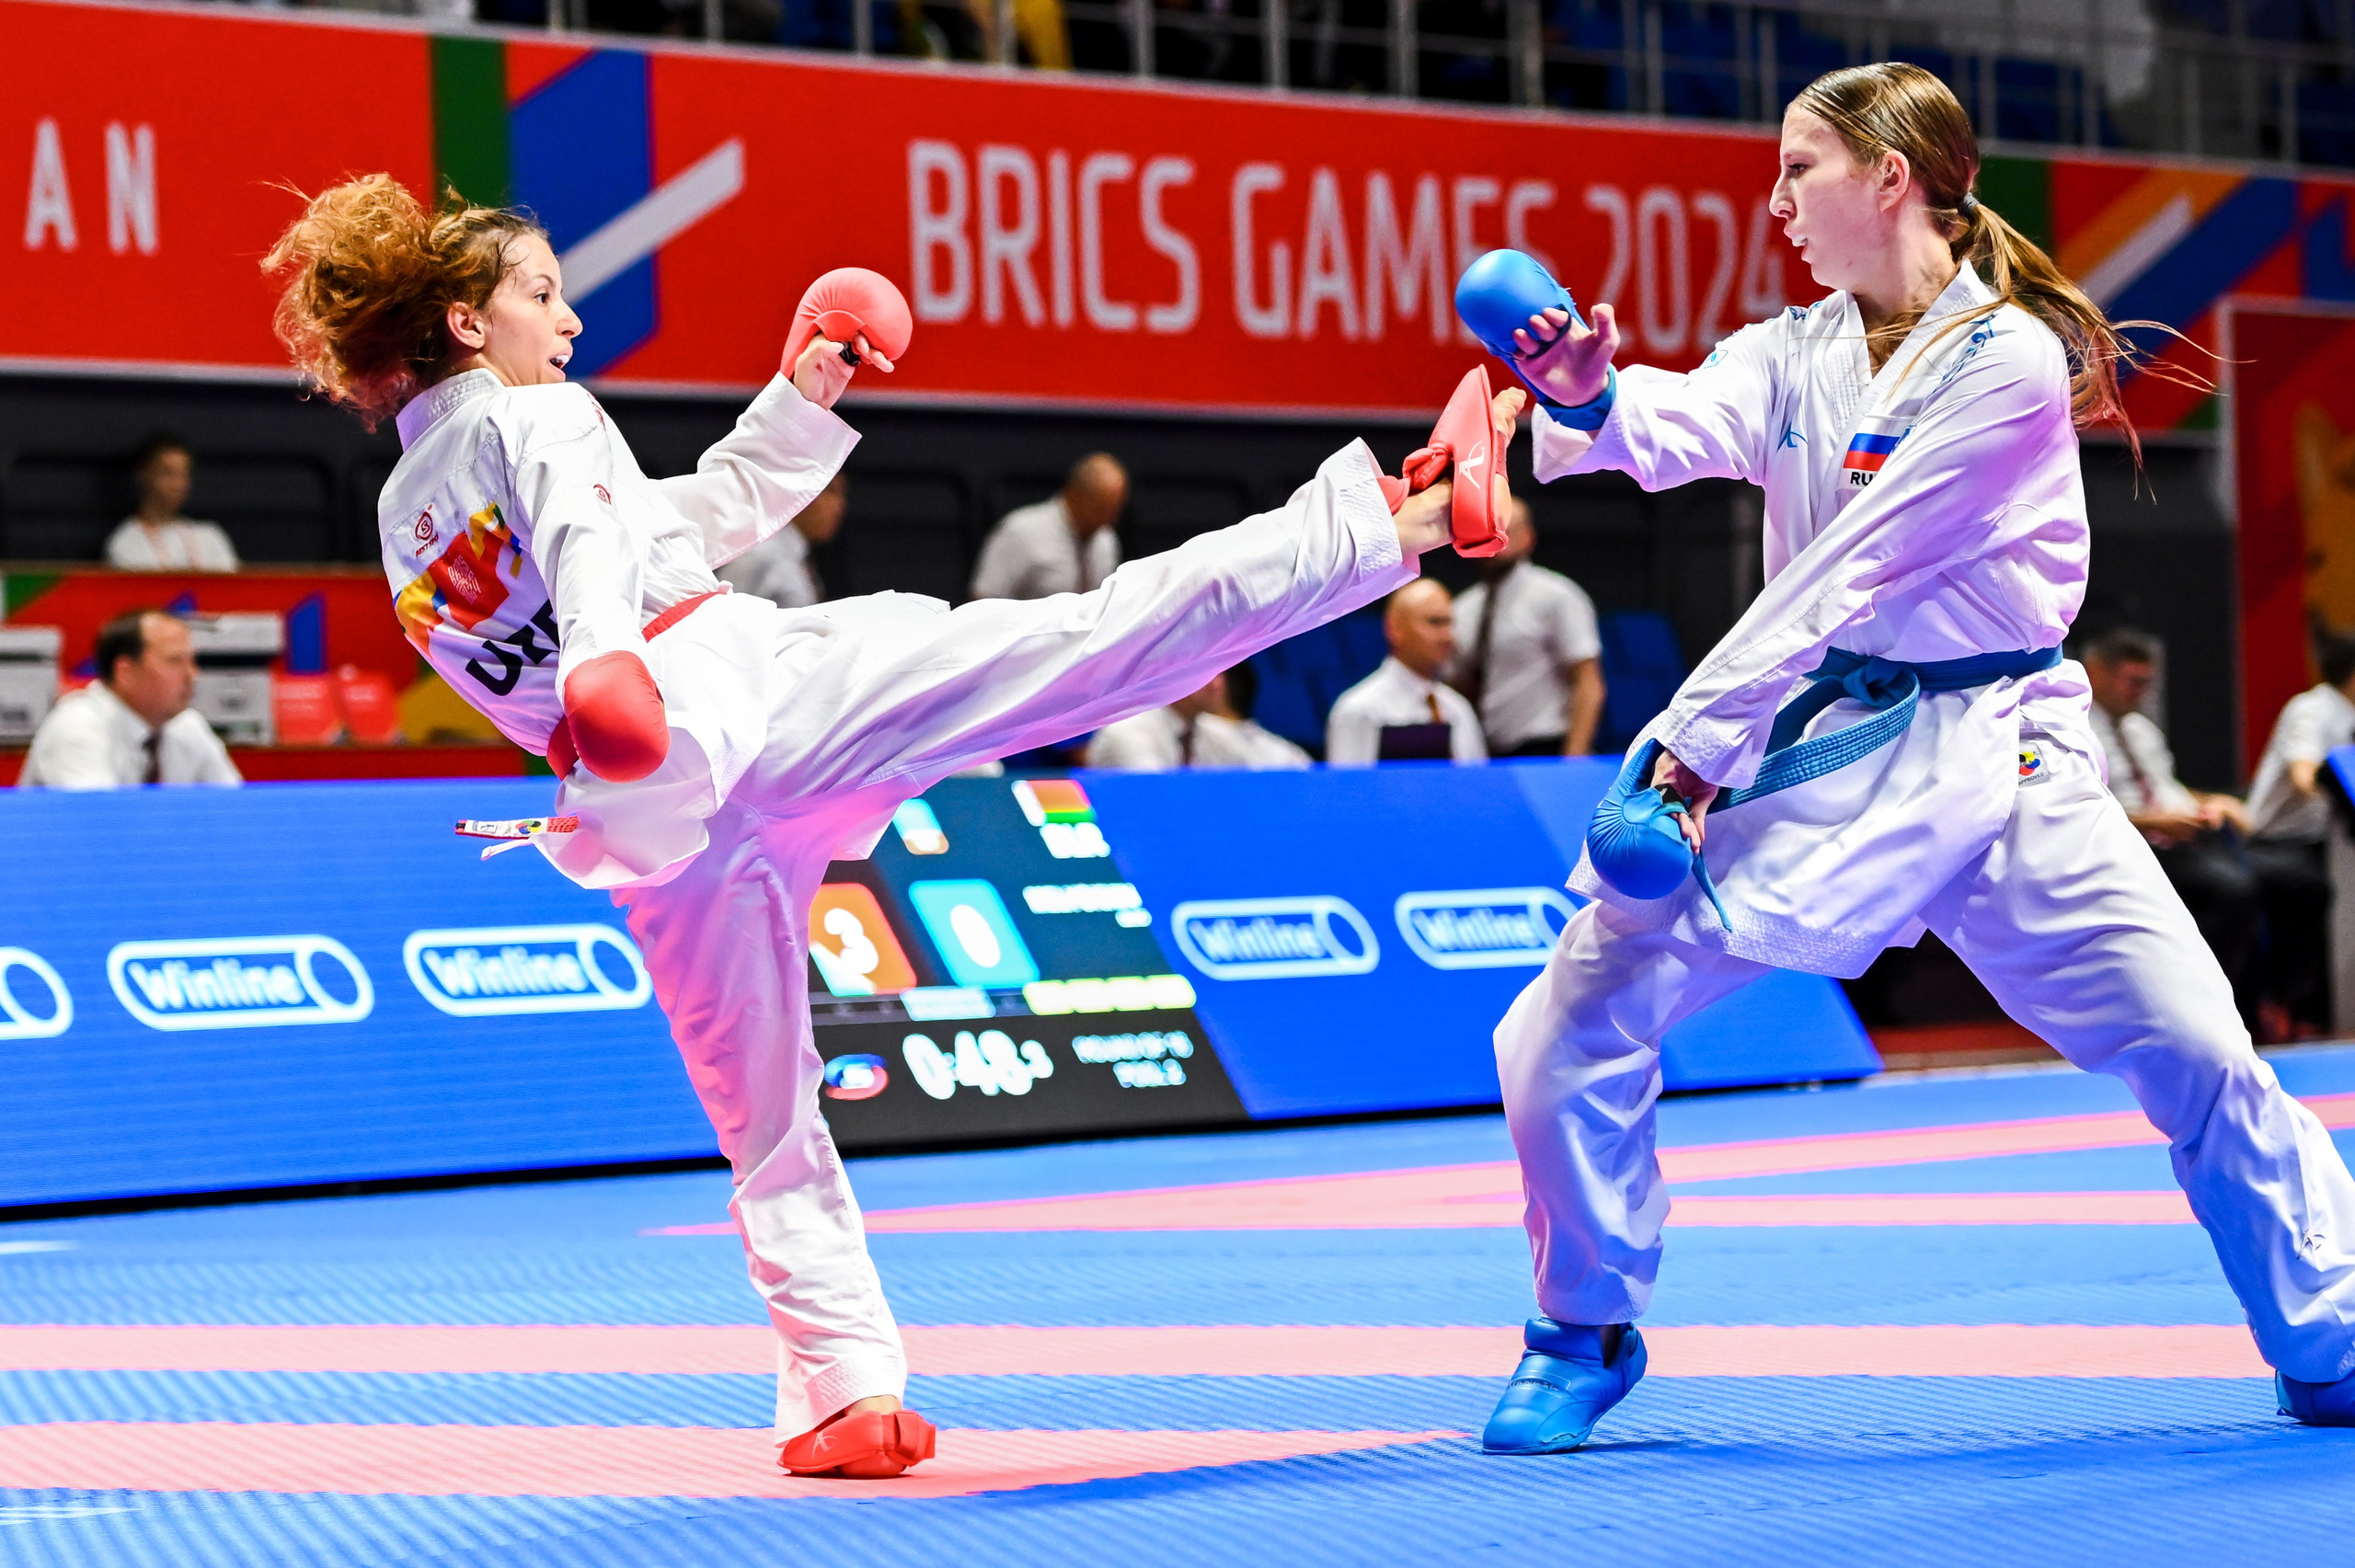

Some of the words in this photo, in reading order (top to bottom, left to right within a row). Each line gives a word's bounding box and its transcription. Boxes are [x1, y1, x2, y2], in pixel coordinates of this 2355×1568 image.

[909, 140, 1200, 334] BRICS
[1850, 471, 1874, 486] RU
[950, 904, 1001, 968] 0
[127, 958, 305, 1010] Winline
[423, 946, 589, 998] Winline
